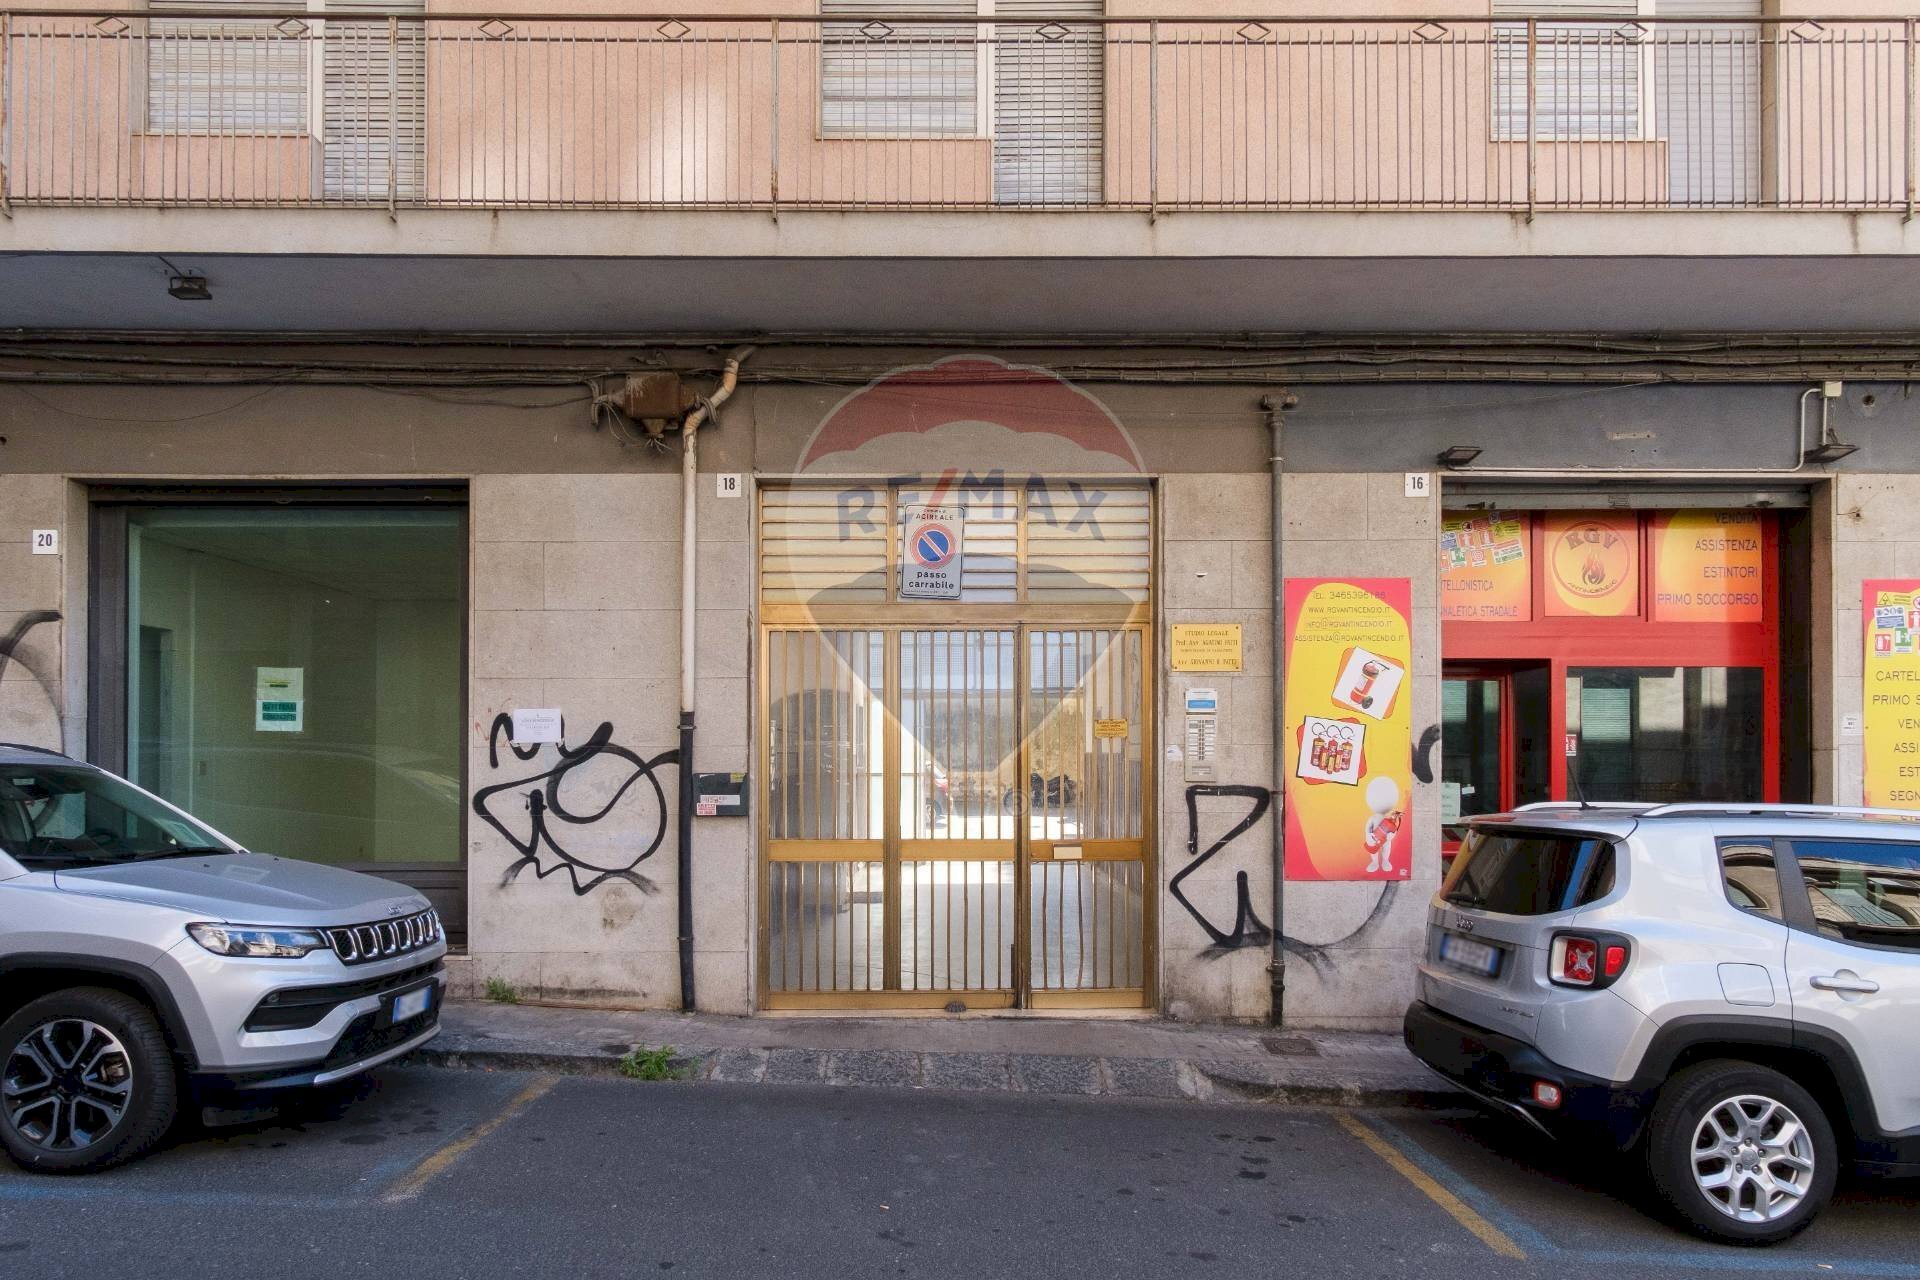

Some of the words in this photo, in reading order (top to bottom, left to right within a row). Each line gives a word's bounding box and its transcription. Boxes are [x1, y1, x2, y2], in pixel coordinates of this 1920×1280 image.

[723, 477, 736, 490] 18
[1411, 476, 1424, 489] 16
[915, 513, 954, 521] ACIREALE
[1714, 511, 1758, 524] VENDITA
[38, 533, 52, 547] 20
[1565, 527, 1618, 550] RGV
[1695, 539, 1758, 552] ASSISTENZA
[916, 571, 947, 579] passo
[1703, 566, 1758, 578] ESTINTORI
[908, 581, 955, 590] carrabile
[1657, 593, 1692, 606] PRIMO
[1696, 593, 1759, 606] SOCCORSO
[1480, 605, 1519, 617] STRADALE
[1872, 694, 1911, 706] PRIMO
[1893, 742, 1919, 753] ASSI
[1899, 766, 1920, 777] EST
